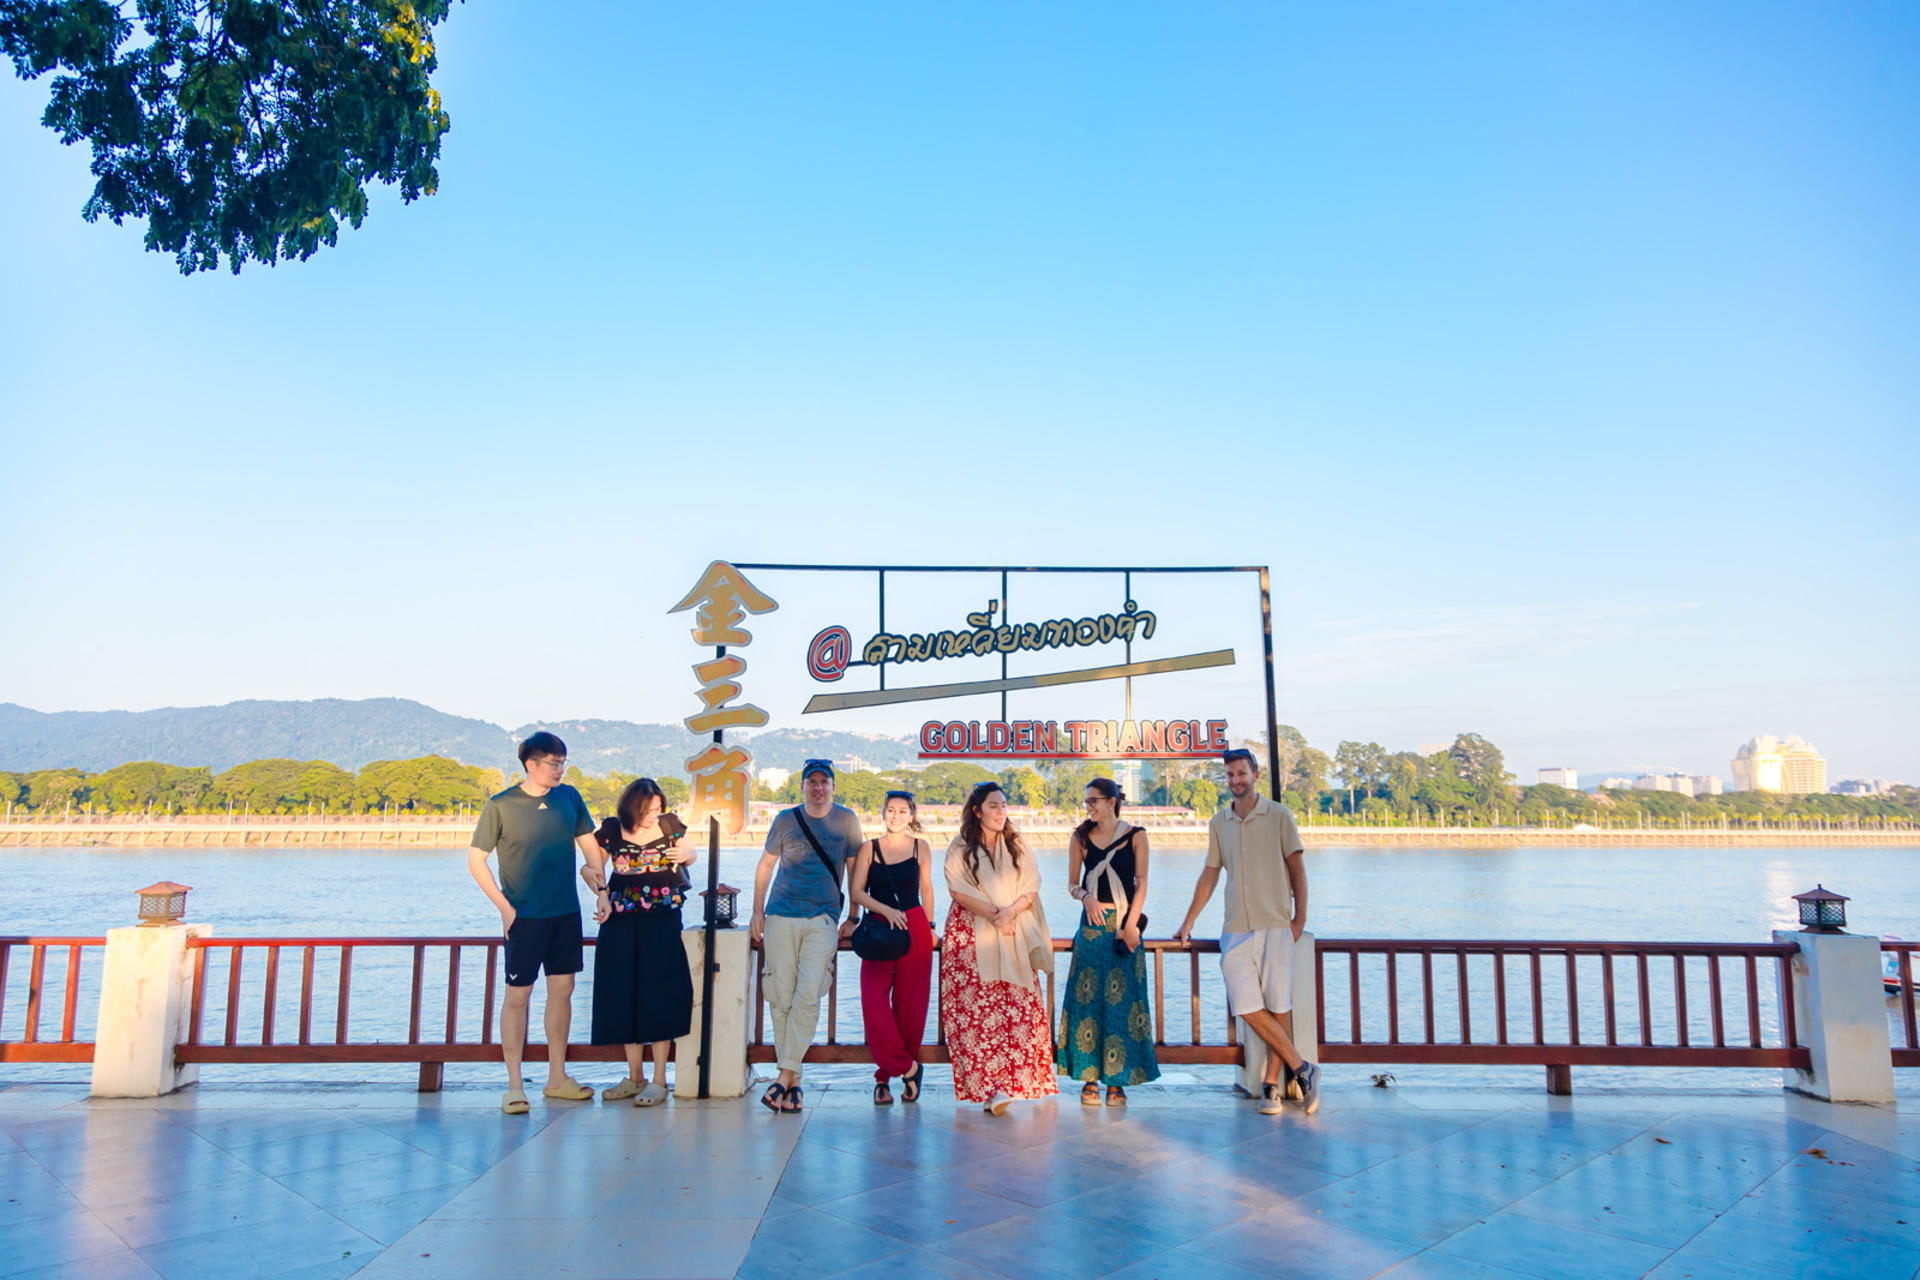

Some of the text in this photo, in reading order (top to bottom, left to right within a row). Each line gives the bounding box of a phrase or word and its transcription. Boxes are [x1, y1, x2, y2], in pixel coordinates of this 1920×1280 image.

[666, 560, 780, 836] 金三角
[920, 719, 1229, 753] GOLDEN TRIANGLE
